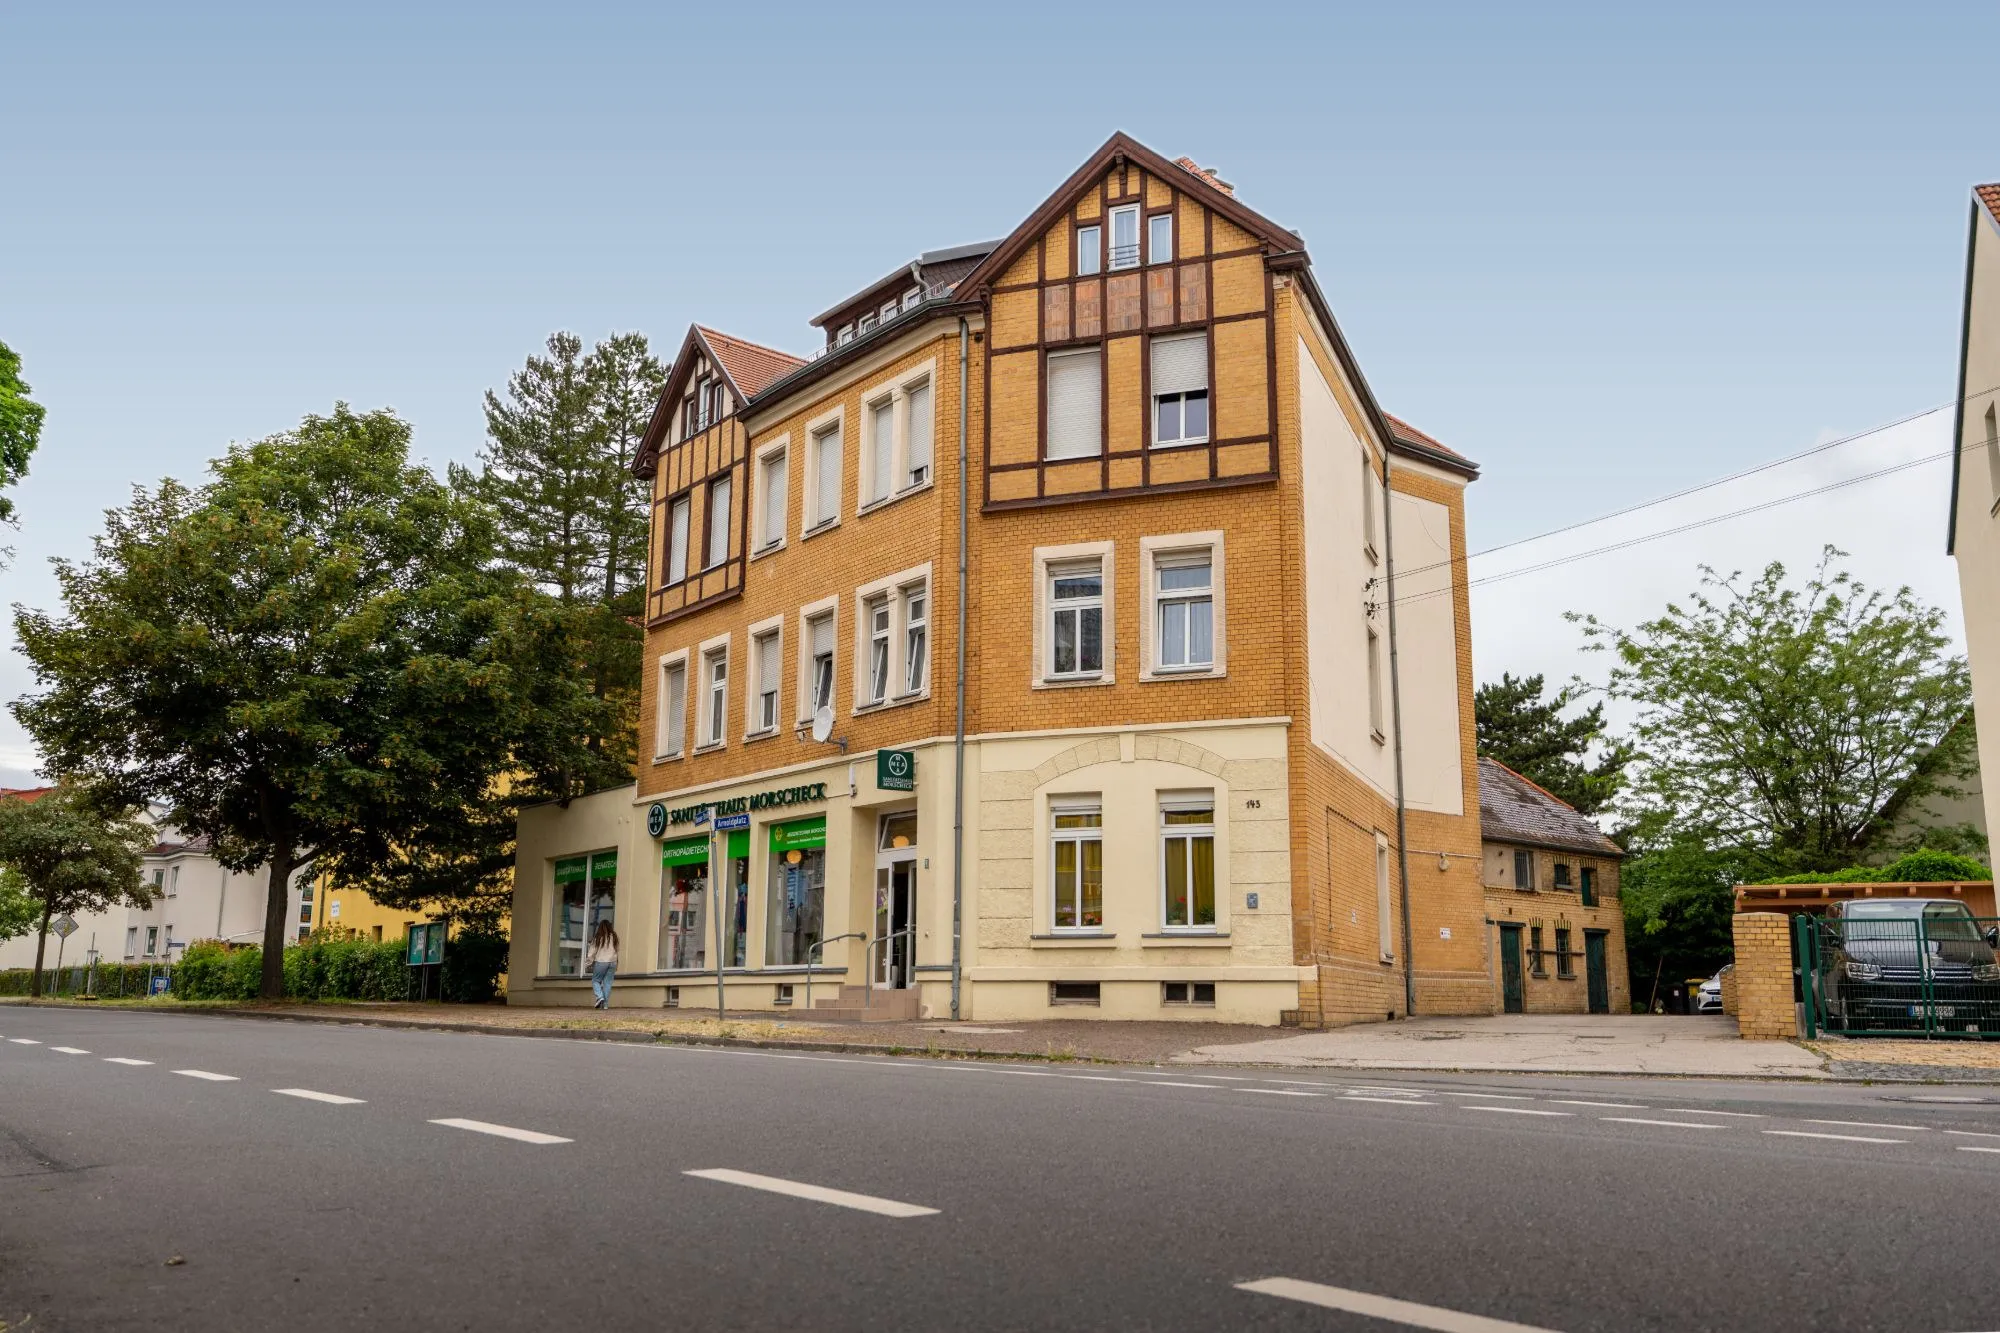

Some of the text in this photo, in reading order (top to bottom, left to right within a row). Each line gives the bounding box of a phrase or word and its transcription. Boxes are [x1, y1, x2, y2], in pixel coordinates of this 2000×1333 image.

[671, 797, 748, 823] SANITHAUS
[750, 783, 827, 810] MORSCHECK
[717, 816, 747, 828] Arnoldplatz
